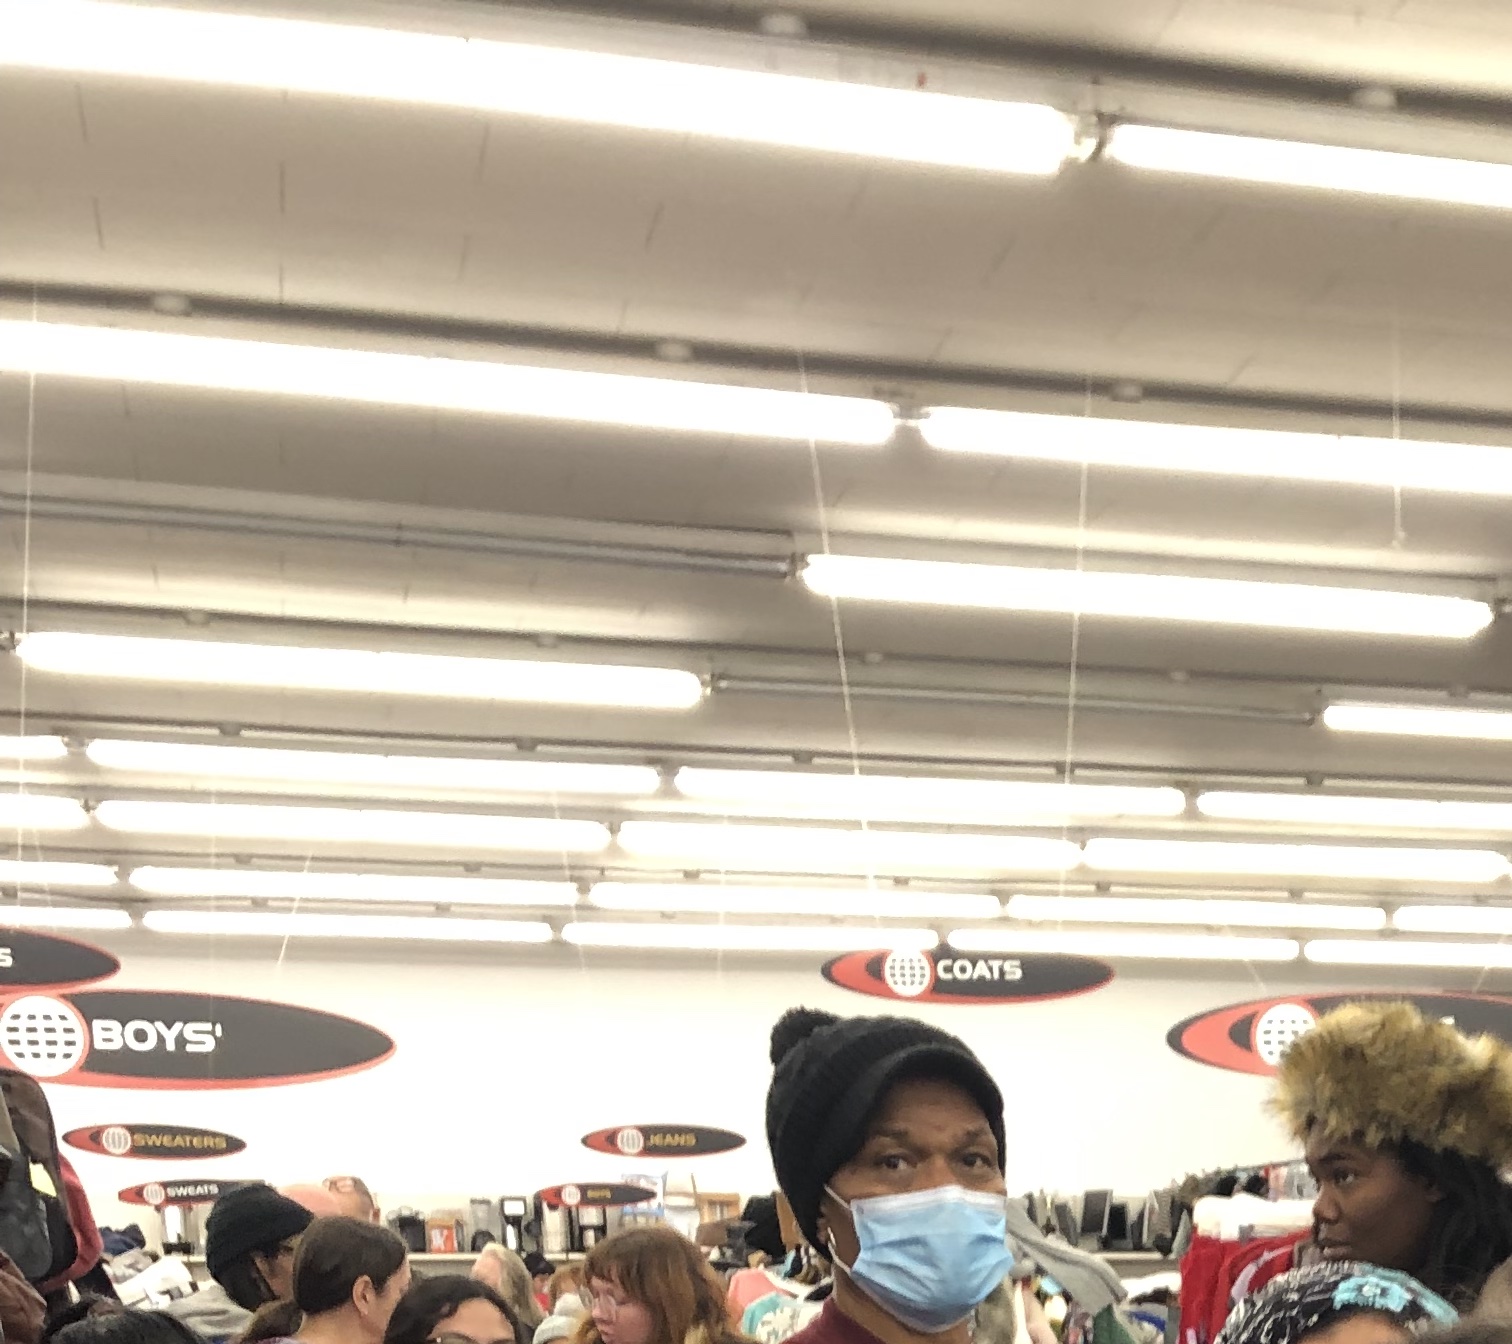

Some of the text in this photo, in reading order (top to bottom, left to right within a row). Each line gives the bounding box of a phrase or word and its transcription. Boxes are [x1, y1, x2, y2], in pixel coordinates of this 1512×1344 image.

[936, 958, 1023, 981] COATS
[91, 1018, 223, 1053] BOYS'
[132, 1132, 228, 1150] SWEATERS
[165, 1183, 220, 1198] SWEATS
